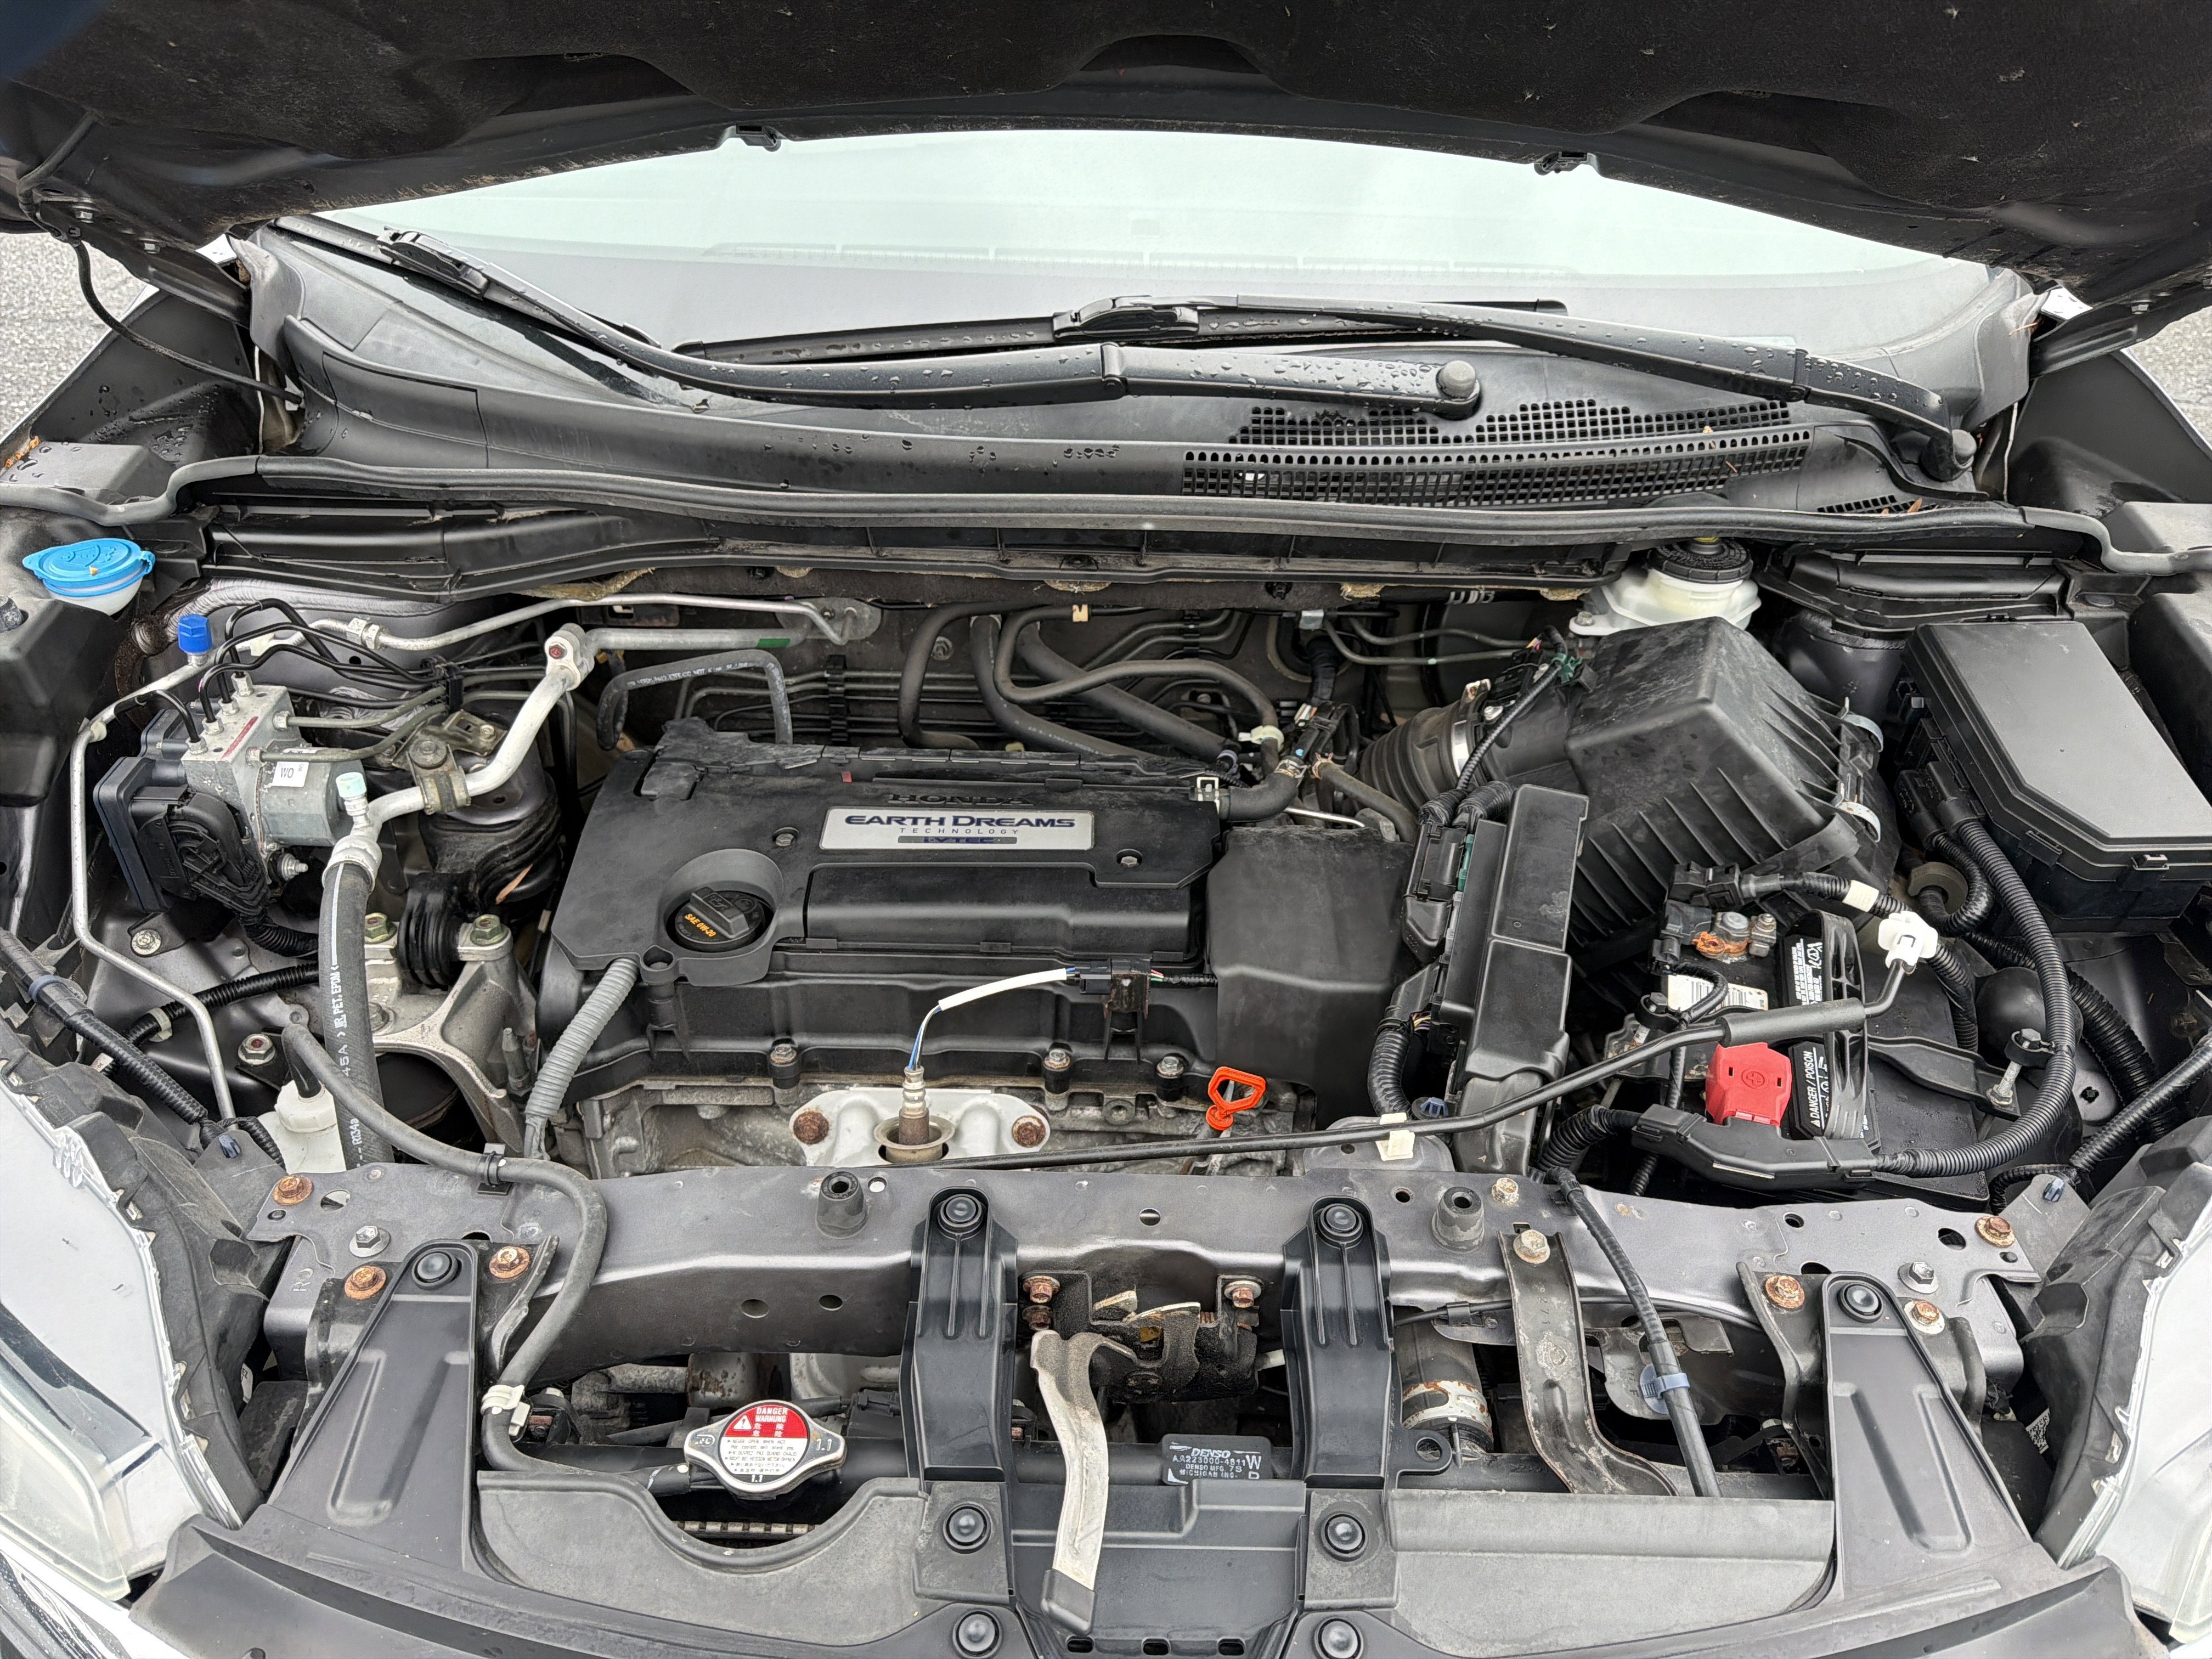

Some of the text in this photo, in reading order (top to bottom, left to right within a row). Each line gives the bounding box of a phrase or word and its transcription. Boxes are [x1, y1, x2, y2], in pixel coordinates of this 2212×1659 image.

[280, 767, 295, 778] WO
[888, 794, 1034, 806] HONDA
[845, 815, 1076, 827] EARTH DREAMS
[684, 913, 701, 925] SAE
[696, 921, 716, 938] 0W-20
[1803, 1051, 1816, 1080] POISON
[1807, 1085, 1820, 1119] DANGER
[815, 1438, 833, 1452] 1.1
[1190, 1448, 1231, 1459] DENSO
[751, 1475, 763, 1483] 1.1
